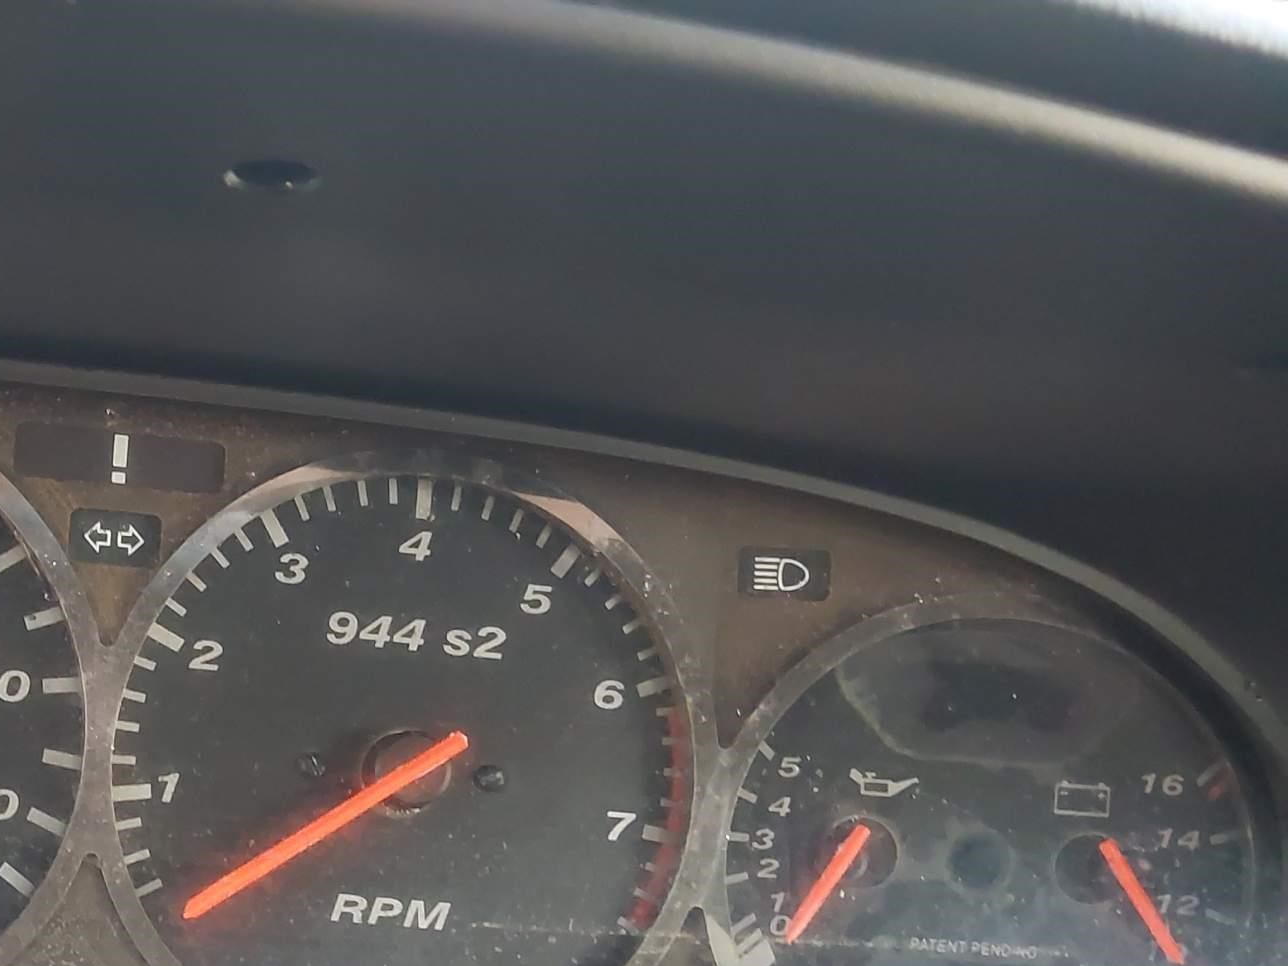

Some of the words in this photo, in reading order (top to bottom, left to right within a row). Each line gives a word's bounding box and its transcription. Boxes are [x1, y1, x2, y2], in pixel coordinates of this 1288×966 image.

[399, 531, 431, 561] 4
[274, 553, 309, 585] 3
[519, 584, 552, 614] 5
[325, 612, 425, 652] 944
[188, 640, 224, 671] 2
[593, 680, 625, 709] 6
[778, 756, 801, 778] 5
[158, 773, 180, 802] 1
[1141, 773, 1185, 796] 16
[768, 797, 791, 817] 4
[606, 813, 637, 841] 7
[752, 828, 775, 850] 3
[1158, 828, 1200, 850] 14
[757, 858, 780, 879] 2
[330, 893, 452, 931] RPM
[771, 892, 785, 912] 1
[1157, 894, 1200, 916] 12
[910, 937, 967, 954] PATENT
